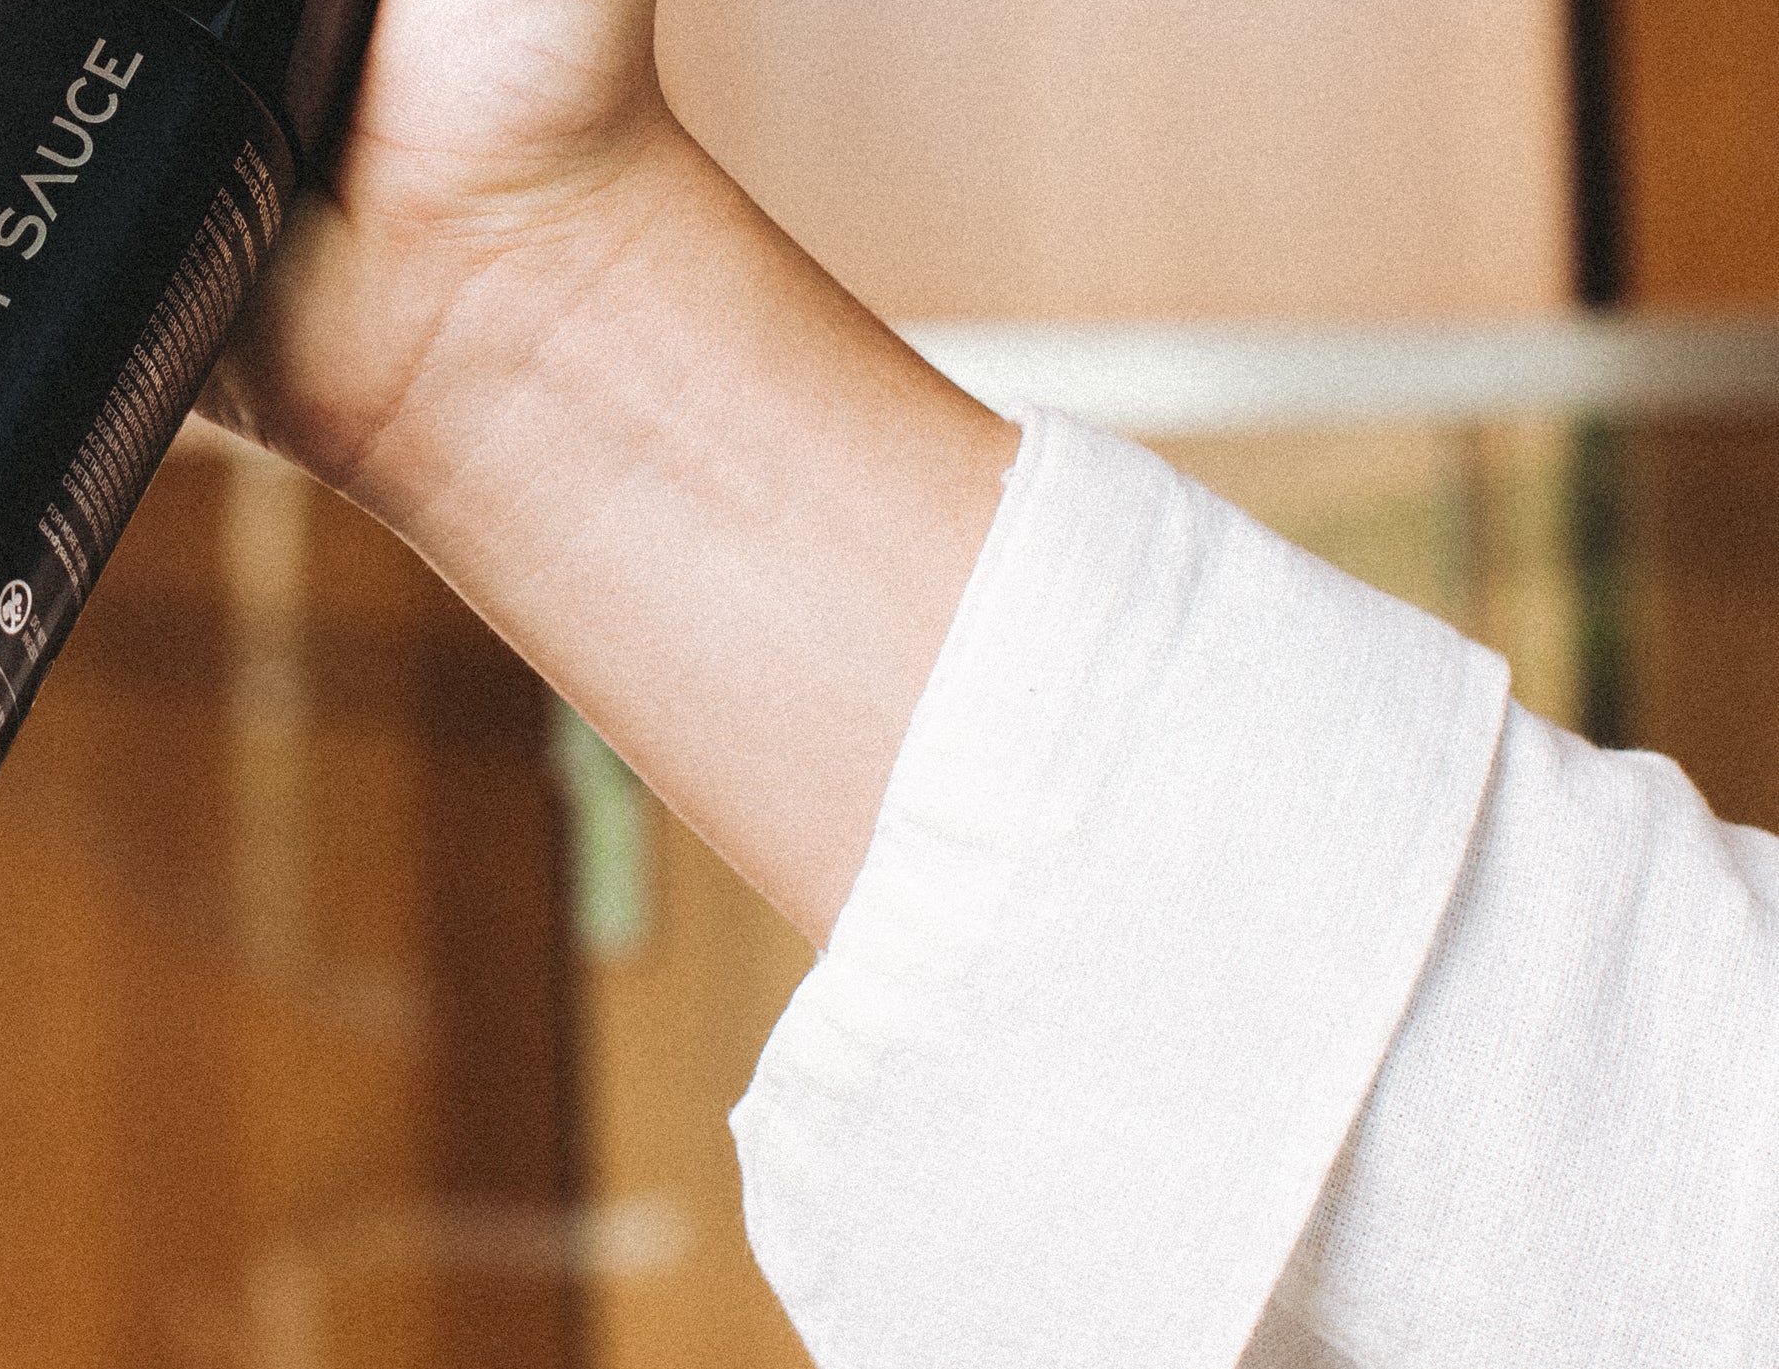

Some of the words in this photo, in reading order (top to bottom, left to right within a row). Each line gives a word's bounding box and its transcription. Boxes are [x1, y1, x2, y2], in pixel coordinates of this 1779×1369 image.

[234, 156, 261, 199] SAUCE
[242, 140, 269, 184] THANK
[218, 187, 234, 211] FOR
[232, 207, 247, 235] BEST
[195, 228, 207, 247] OF
[180, 257, 203, 293] COMES
[188, 243, 210, 277] SPRAY
[150, 314, 174, 352] POISON
[95, 414, 121, 454] SODIUM
[47, 502, 64, 527] FOR
